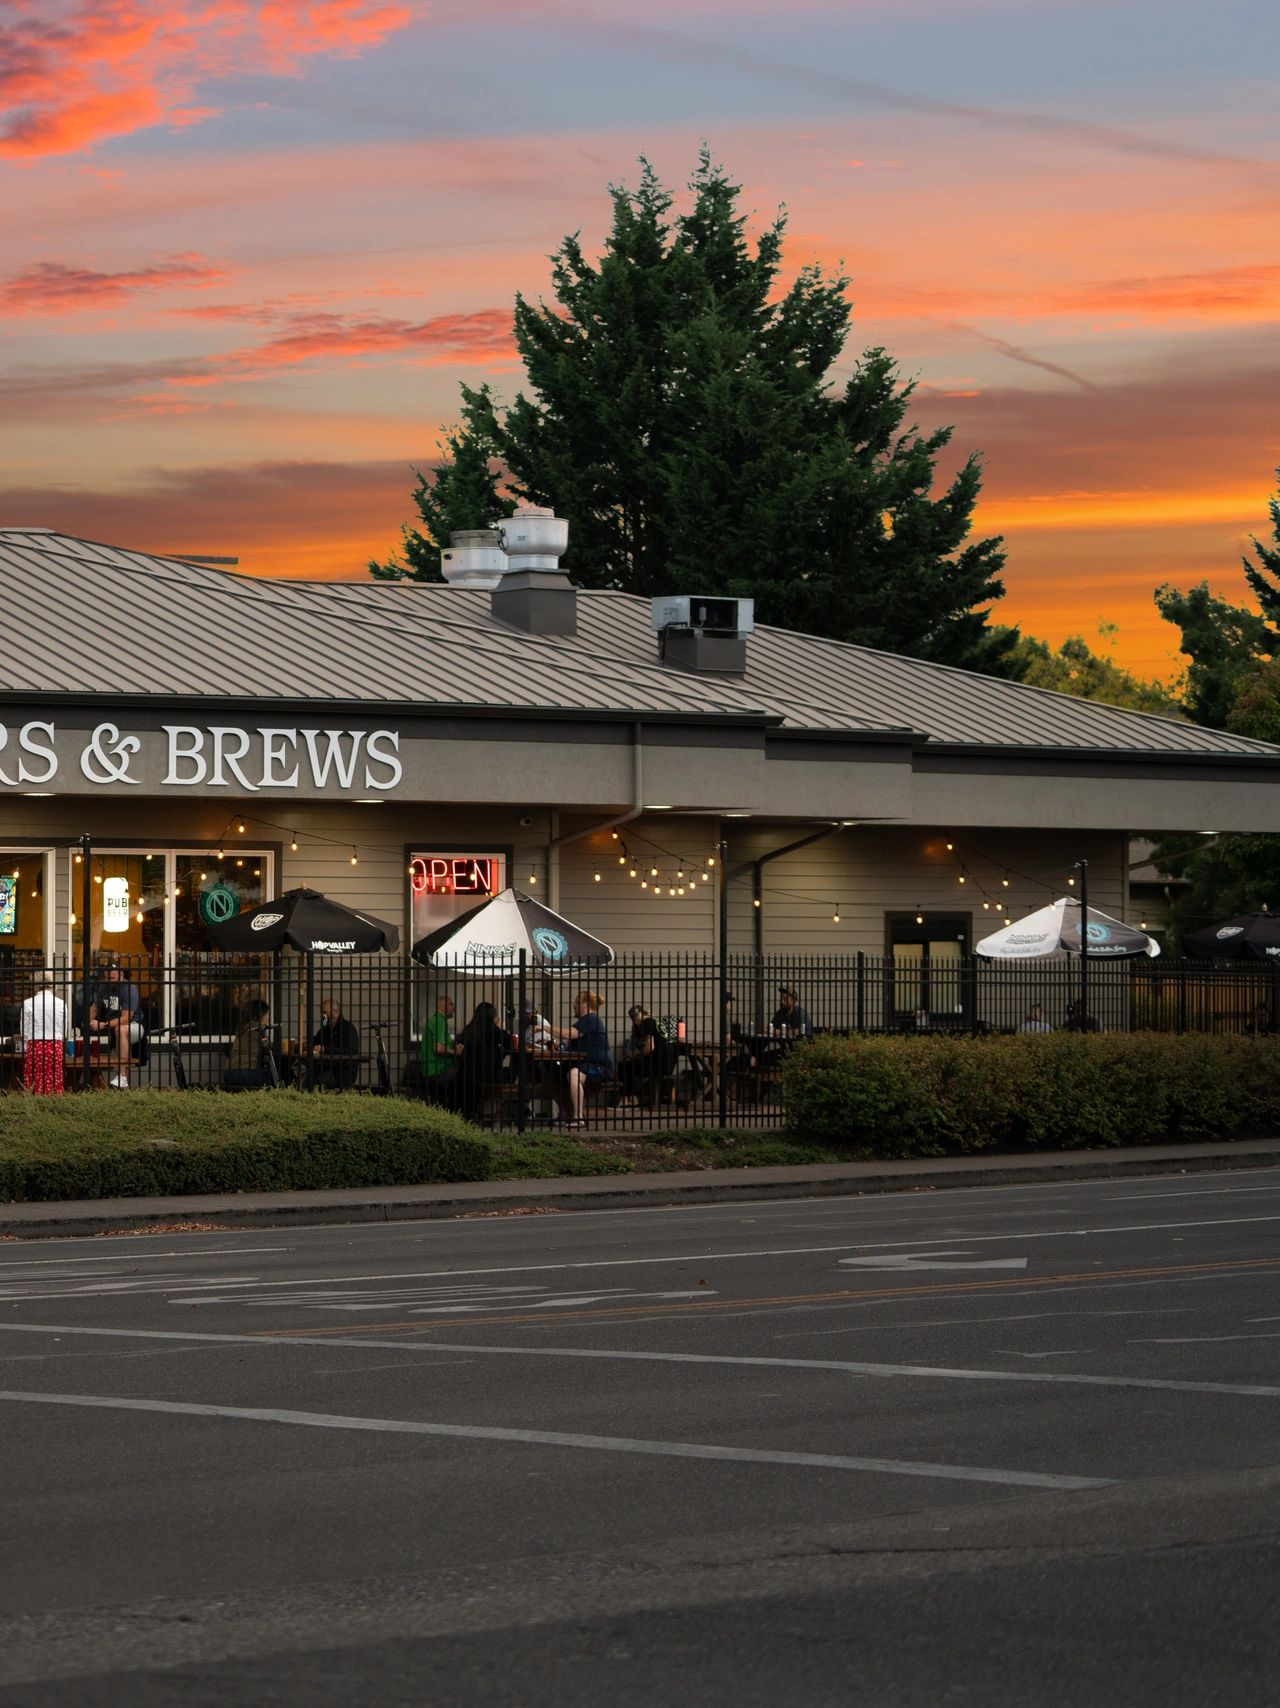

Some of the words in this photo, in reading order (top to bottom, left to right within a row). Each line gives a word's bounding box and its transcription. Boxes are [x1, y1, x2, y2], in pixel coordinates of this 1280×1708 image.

[80, 722, 141, 785] &
[161, 724, 403, 790] BREWS
[411, 859, 491, 891] OPEN
[108, 898, 128, 908] PUB
